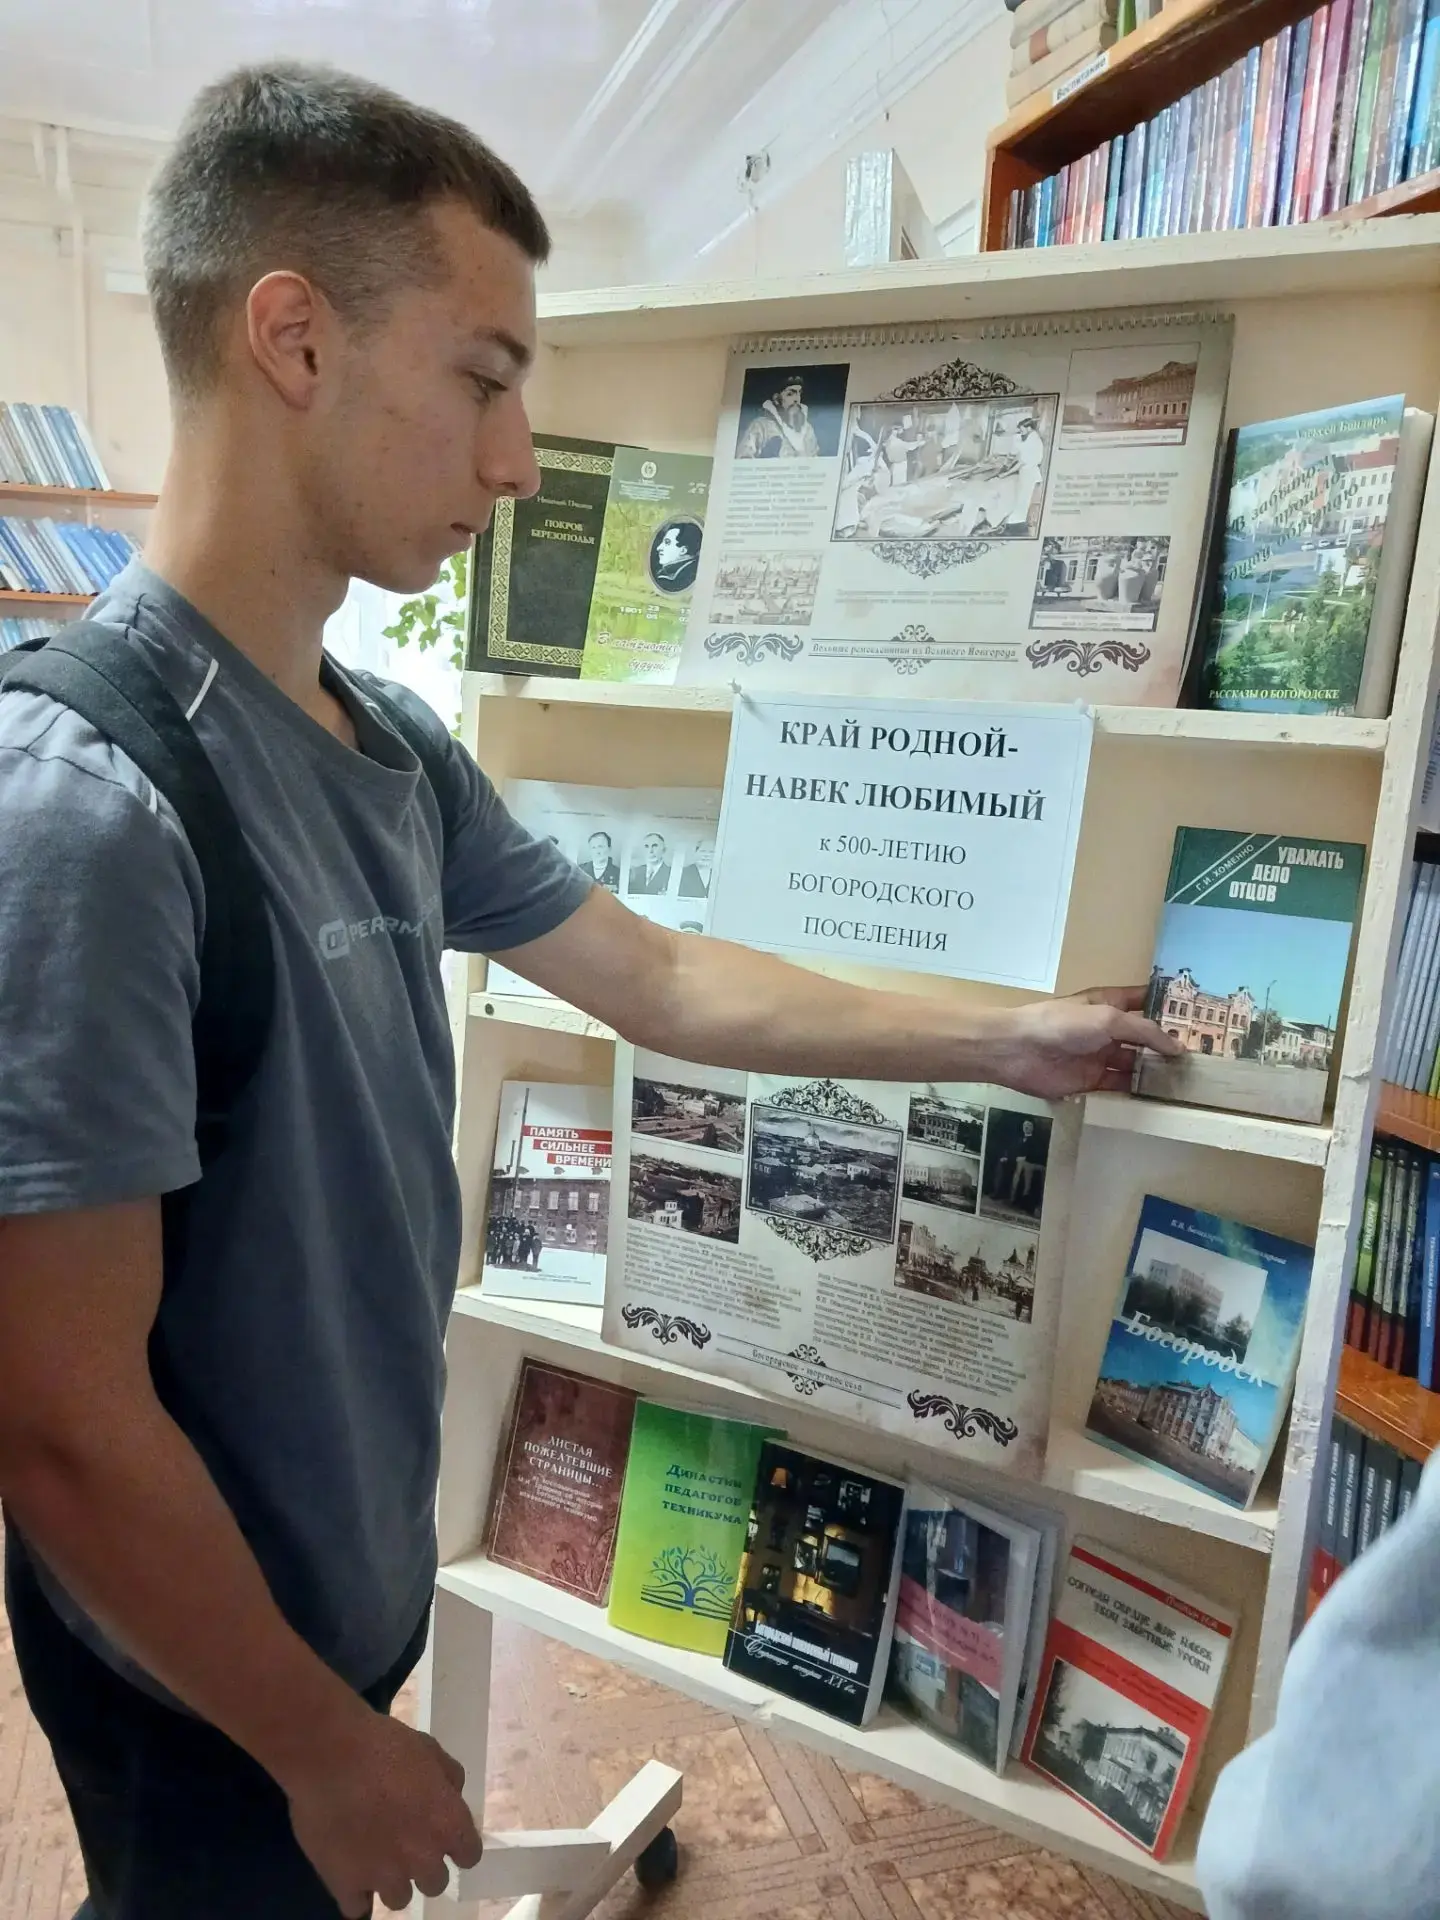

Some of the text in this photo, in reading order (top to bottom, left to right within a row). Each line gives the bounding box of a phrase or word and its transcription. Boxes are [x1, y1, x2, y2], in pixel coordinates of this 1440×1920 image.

[544, 519, 583, 531] ПОКРОВ
[1208, 689, 1340, 700] РАССКАЗЫ О БОГОРОДСКЕ
[779, 719, 1019, 760] КРАЙ РОДНОЙ-
[745, 773, 1047, 822] НАВЕК ЛЮБИМЫЙ
[819, 835, 967, 865] к 500-ЛЕТИЮ
[1277, 846, 1344, 870] УВАЖАТЬ
[1251, 863, 1291, 884] ДЕЛО
[788, 871, 975, 911] БОГОРОДСКОГО
[1228, 880, 1277, 903] ОТЦОВ
[803, 916, 948, 952] ПОСЕЛЕНИЯ
[529, 1125, 580, 1140] ПАМЯТЬ
[539, 1140, 596, 1154] СИЛЬНЕЕ
[555, 1153, 612, 1169] ВРЕМЕНИ
[1123, 1310, 1263, 1388] Богородск
[548, 1435, 593, 1458] ЛИСТАЯ
[524, 1440, 613, 1478] ПОЖЕЛТЕВШИЕ
[529, 1456, 603, 1489] СТРАНИЦЫ...
